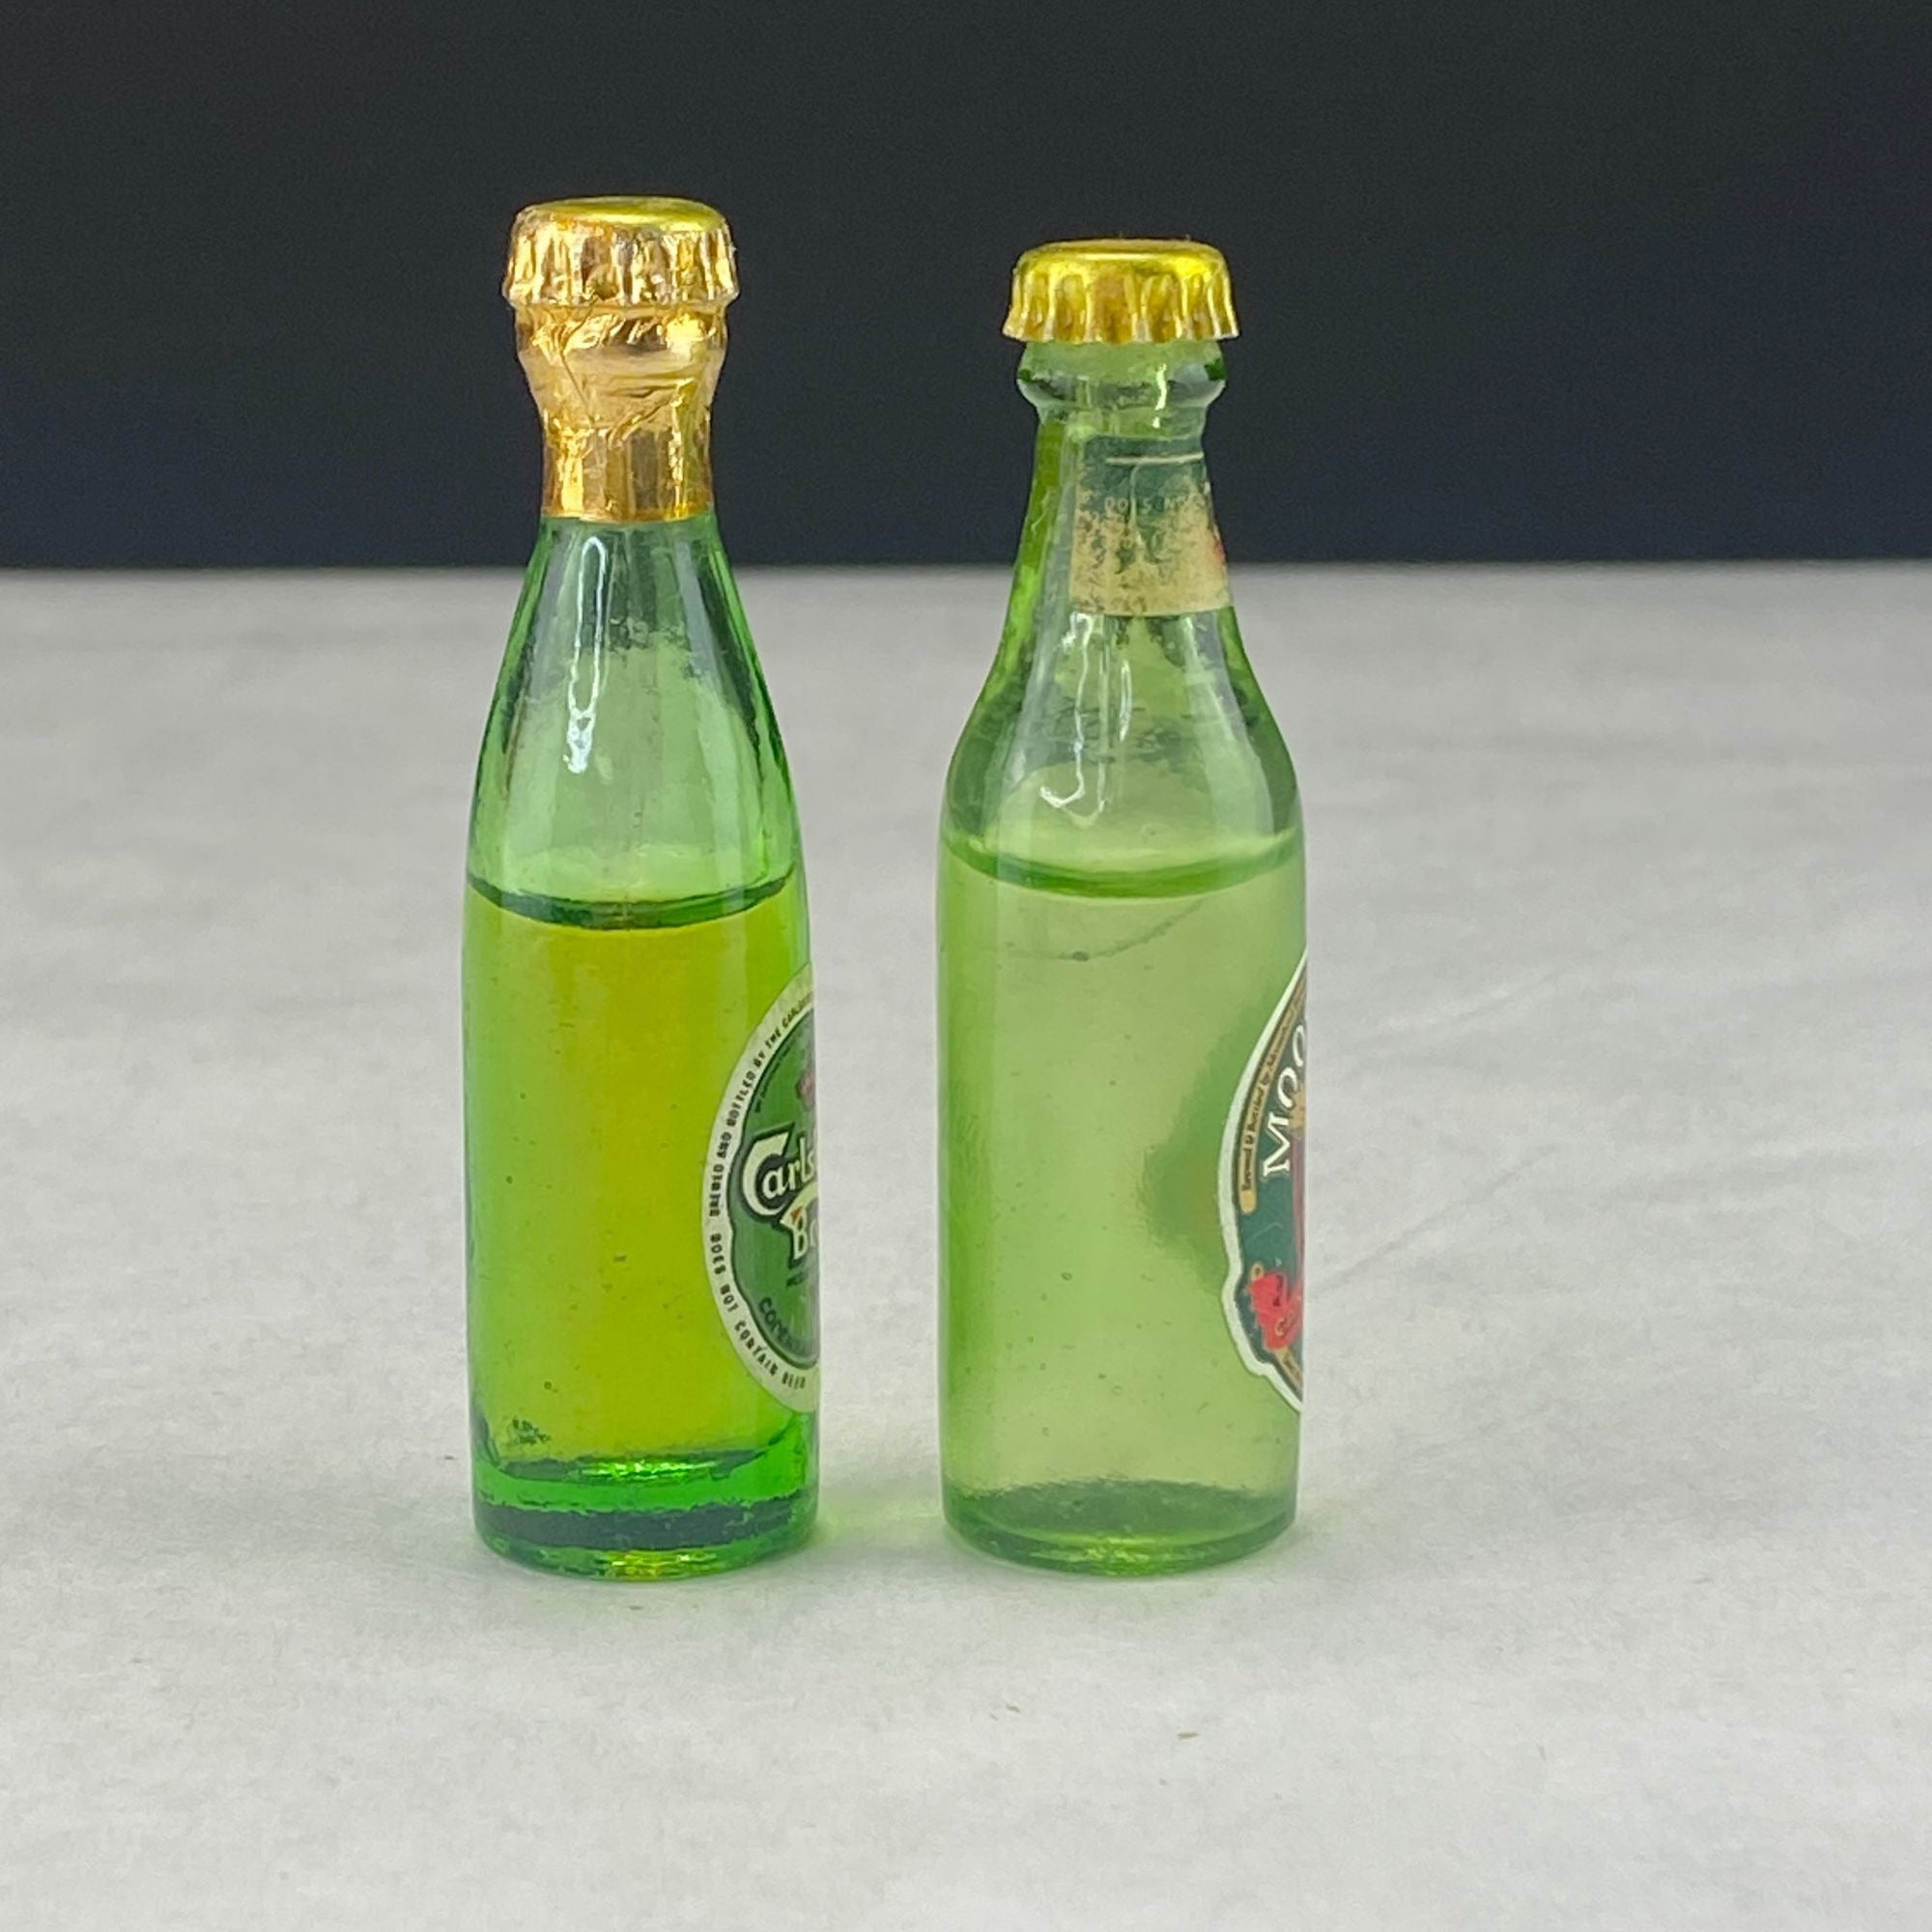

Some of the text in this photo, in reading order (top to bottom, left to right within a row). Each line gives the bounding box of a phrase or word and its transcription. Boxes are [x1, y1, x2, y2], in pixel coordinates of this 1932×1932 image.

[716, 1131, 732, 1158] AND
[725, 1070, 755, 1127] BOTTLED
[710, 1233, 726, 1275] DOES
[720, 1284, 739, 1313] NOT
[734, 1320, 779, 1377] CONTAIN
